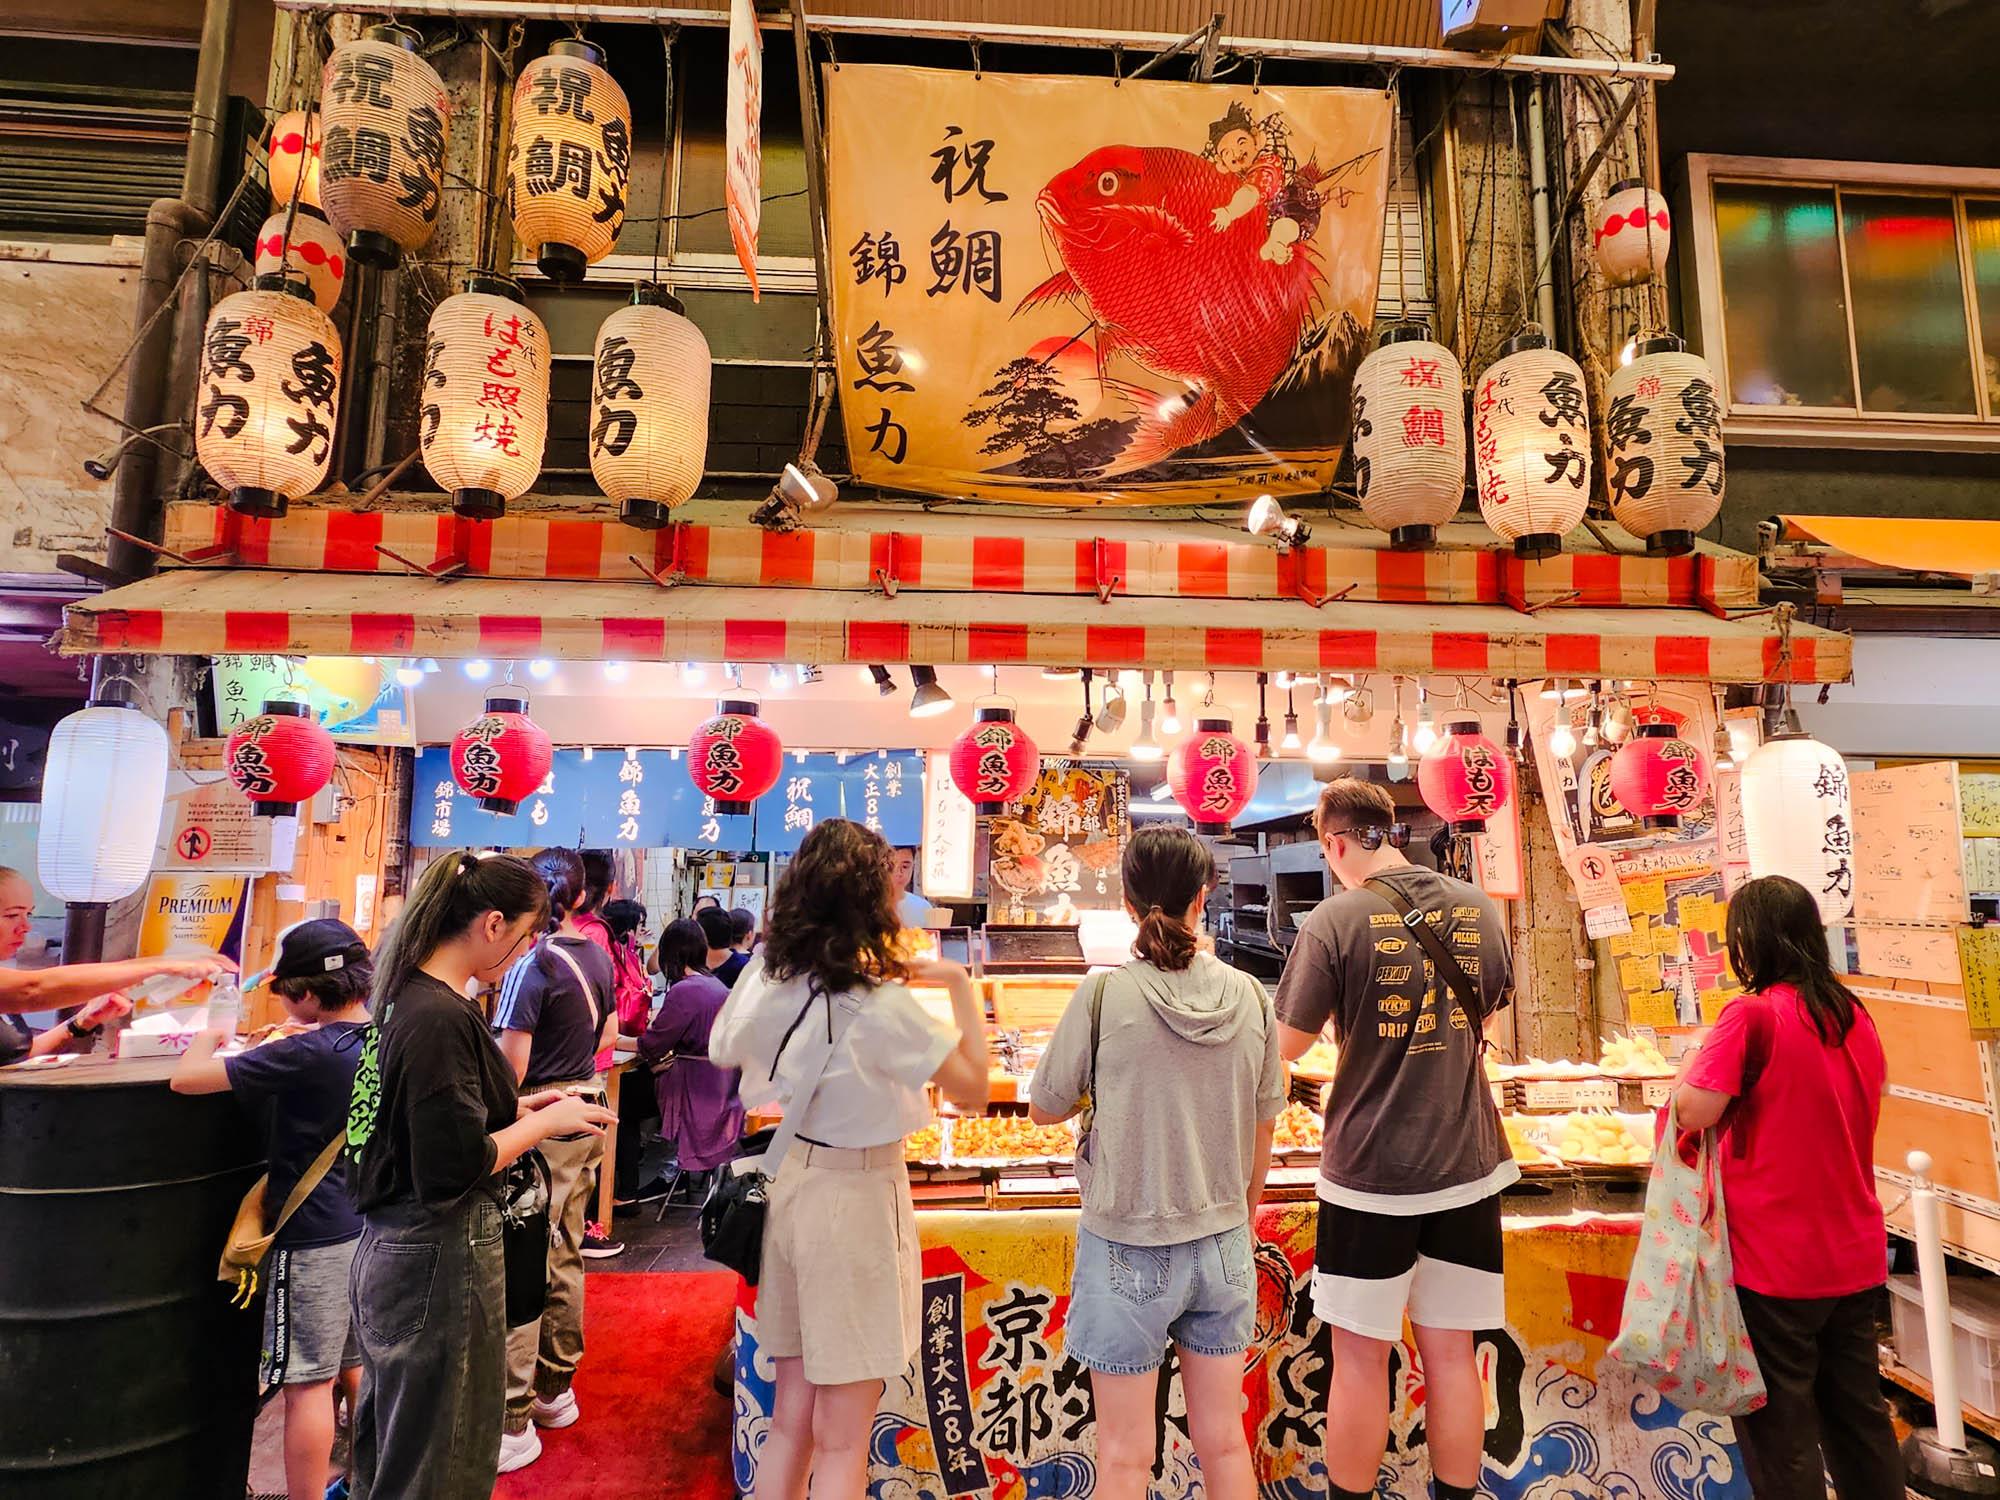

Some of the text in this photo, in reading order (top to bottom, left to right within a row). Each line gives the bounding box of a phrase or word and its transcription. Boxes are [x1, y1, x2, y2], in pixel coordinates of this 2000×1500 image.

[324, 53, 394, 184] 祝鯛
[526, 67, 595, 200] 祝鯛
[926, 126, 1008, 303] 祝鯛
[242, 315, 275, 346] 錦
[521, 319, 537, 370] 名代
[848, 231, 916, 464] 錦魚力
[201, 317, 255, 439] 魚力
[281, 340, 337, 466] 魚力
[474, 312, 524, 457] はも照焼
[591, 336, 644, 458] 魚力
[1400, 356, 1445, 448] 祝鯛
[1496, 370, 1515, 416] 名代
[1634, 375, 1660, 400] 錦
[1538, 371, 1588, 489] 魚力
[1606, 393, 1655, 506] 魚力
[1675, 378, 1723, 496] 魚力
[233, 718, 275, 793] 錦魚力
[463, 716, 504, 793] 錦魚力
[705, 717, 744, 794] 錦魚力
[885, 761, 902, 798] 創業
[976, 727, 1012, 794] 錦魚力
[1201, 738, 1236, 810] 錦魚力
[1457, 746, 1496, 815] はも天
[1655, 740, 1697, 809] 錦魚力
[431, 781, 454, 838] 錦市場
[617, 760, 644, 842] 錦魚力
[784, 776, 814, 833] 祝鯛
[863, 763, 882, 833] 大正8年
[1082, 795, 1100, 832] 京都
[1812, 763, 1852, 898] 錦魚力
[186, 884, 214, 898] The
[1037, 794, 1083, 925] 錦魚力
[158, 897, 233, 914] PREMIUM
[1369, 914, 1402, 925] EXTRA
[1378, 1023, 1408, 1038] DRIP
[279, 1250, 287, 1281] ODUCTS
[276, 1288, 285, 1363] OUTDOOR PRODUCTS
[926, 1292, 978, 1477] 創業大正8年
[976, 1287, 1055, 1461] 京都
